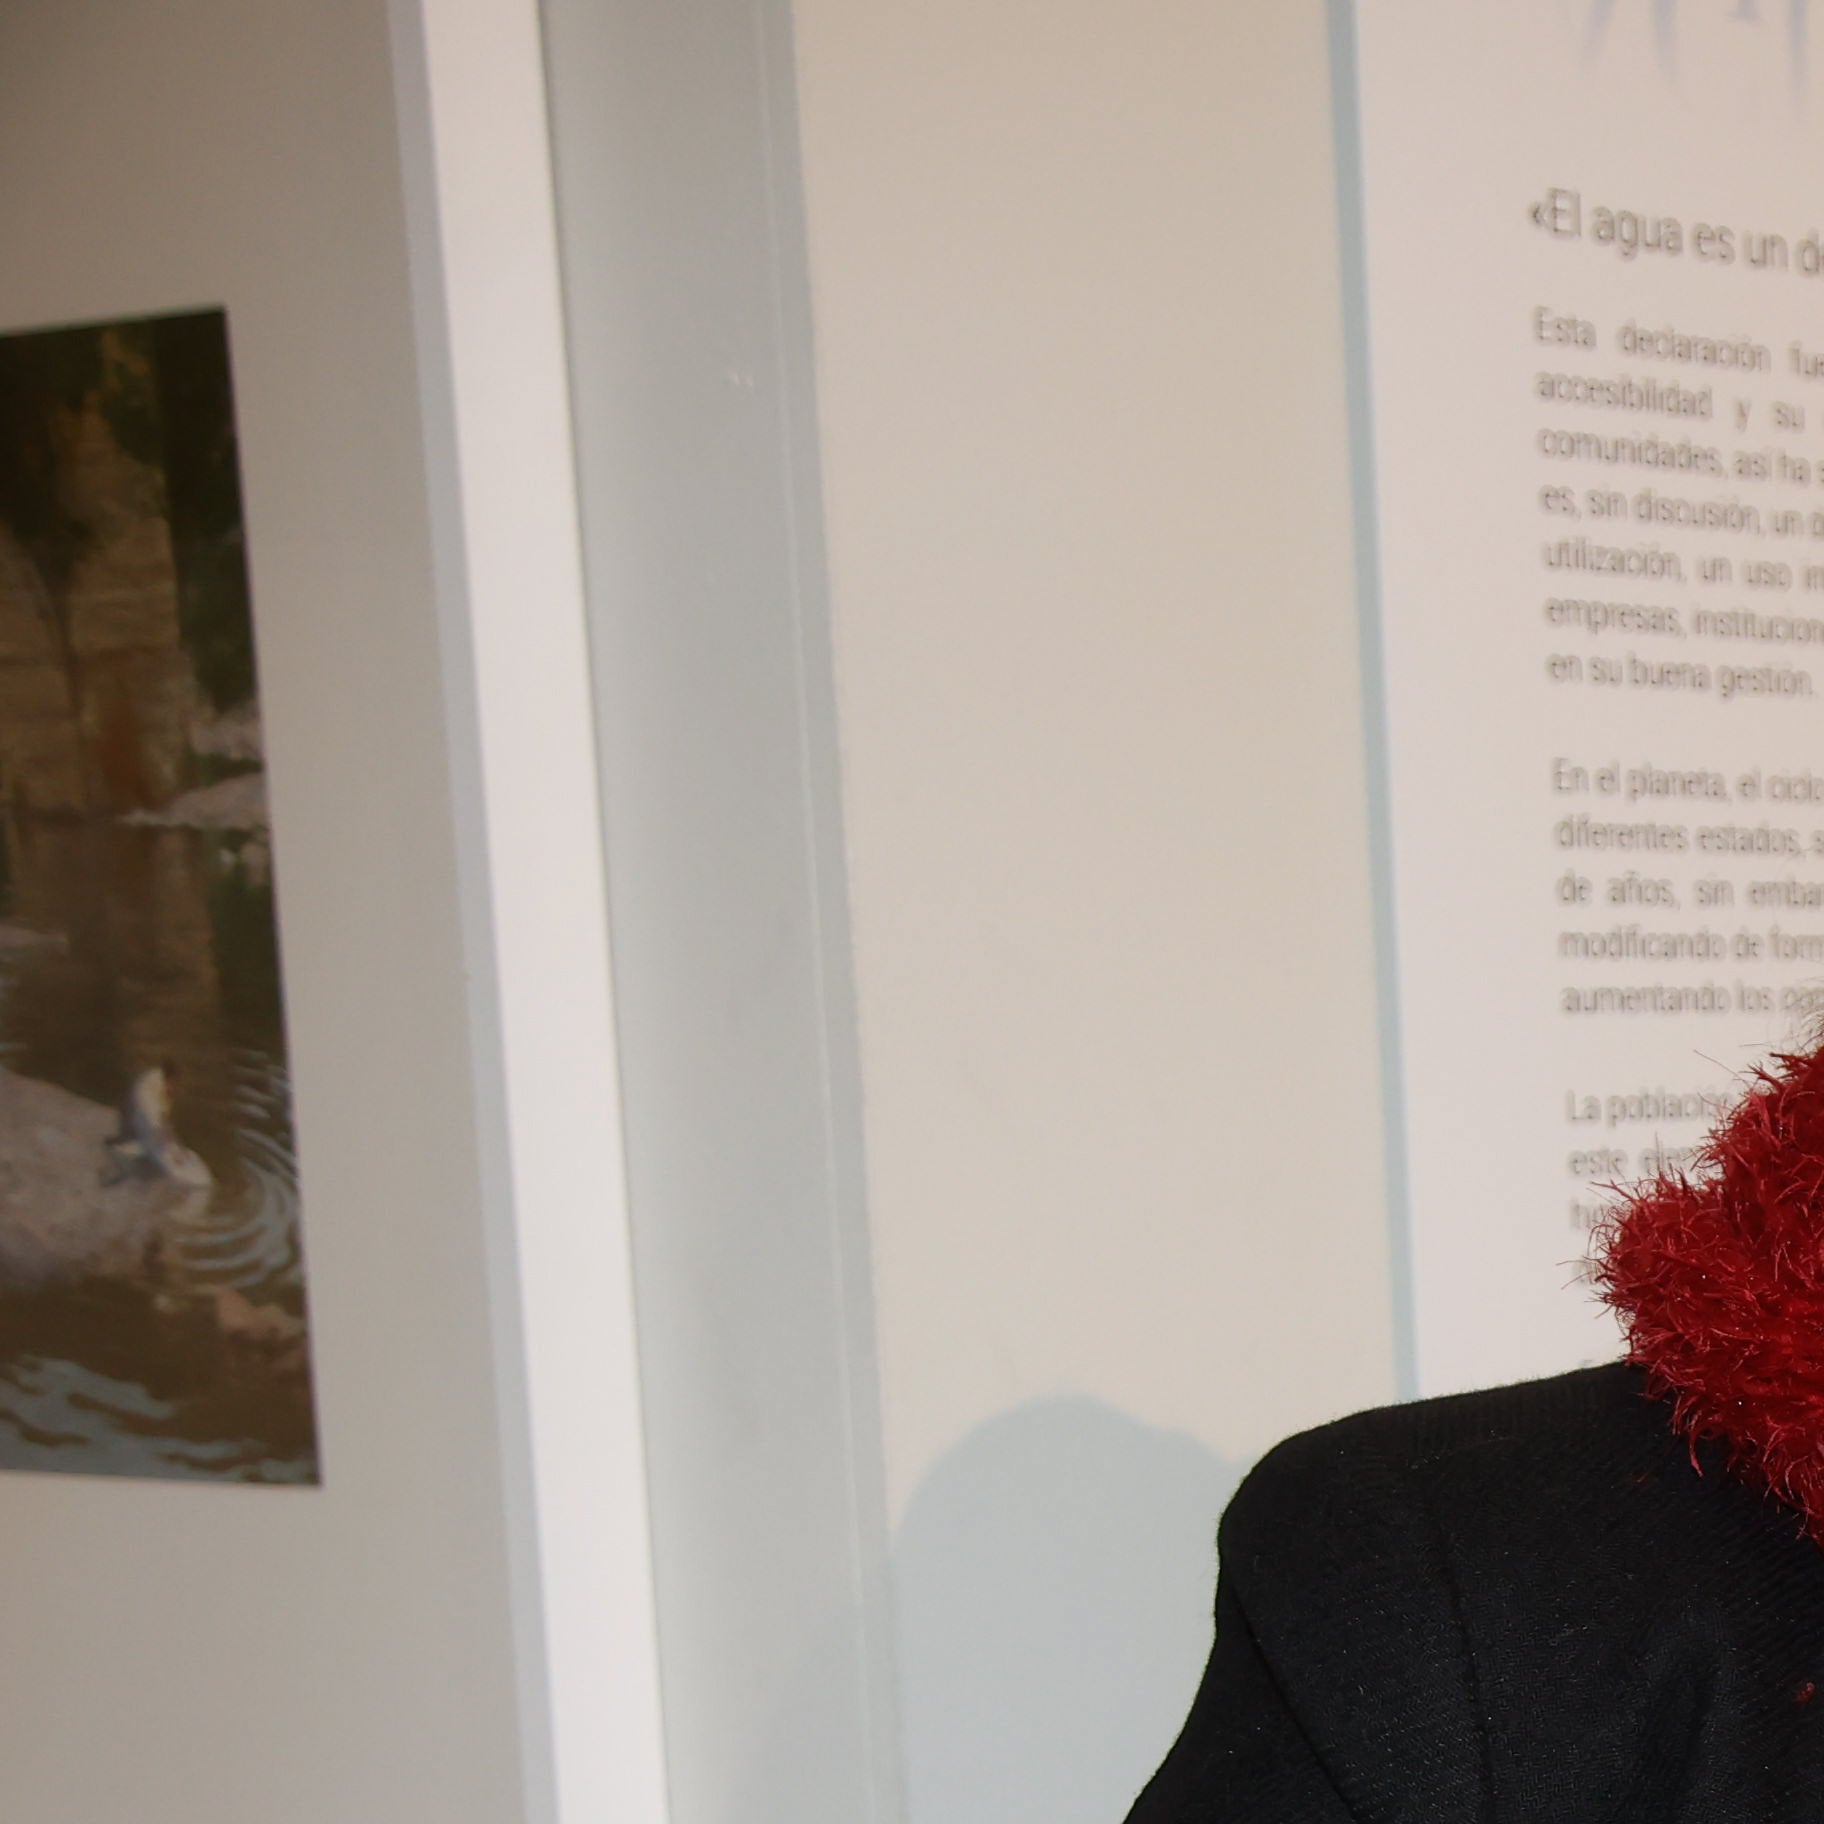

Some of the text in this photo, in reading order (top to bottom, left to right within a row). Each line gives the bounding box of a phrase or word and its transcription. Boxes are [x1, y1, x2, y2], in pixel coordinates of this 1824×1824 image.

[1593, 206, 1682, 259] agua
[1695, 222, 1734, 263] es
[1744, 232, 1788, 269] un
[1533, 306, 1596, 348] Esta
[1619, 317, 1770, 370] declaración
[1536, 372, 1712, 419] accesibilidad
[1736, 400, 1750, 432] y
[1774, 402, 1804, 430] su
[1536, 428, 1728, 479] comunidades,
[1733, 447, 1770, 480] así
[1776, 450, 1810, 483] ha
[1539, 485, 1580, 518] es,
[1586, 481, 1626, 517] sin
[1633, 488, 1765, 536] discusión,
[1769, 510, 1803, 539] un
[1543, 536, 1686, 583] utilización,
[1697, 555, 1732, 583] un
[1744, 559, 1793, 590] uso
[1546, 598, 1687, 639] empresas,
[1548, 652, 1815, 700] en su buena gestión.
[1552, 757, 1589, 793] En
[1595, 760, 1619, 793] el
[1626, 759, 1732, 804] planeta,
[1737, 765, 1761, 798] el
[1554, 813, 1688, 851] diferentes
[1696, 820, 1805, 858] estados,
[1556, 868, 1591, 902] de
[1606, 870, 1680, 910] años,
[1695, 875, 1735, 906] sin
[1557, 923, 1727, 962] modificando
[1731, 925, 1764, 961] de
[1560, 979, 1730, 1015] aumentando
[1734, 977, 1775, 1014] los
[1566, 1088, 1601, 1125] La
[1568, 1145, 1628, 1175] este
